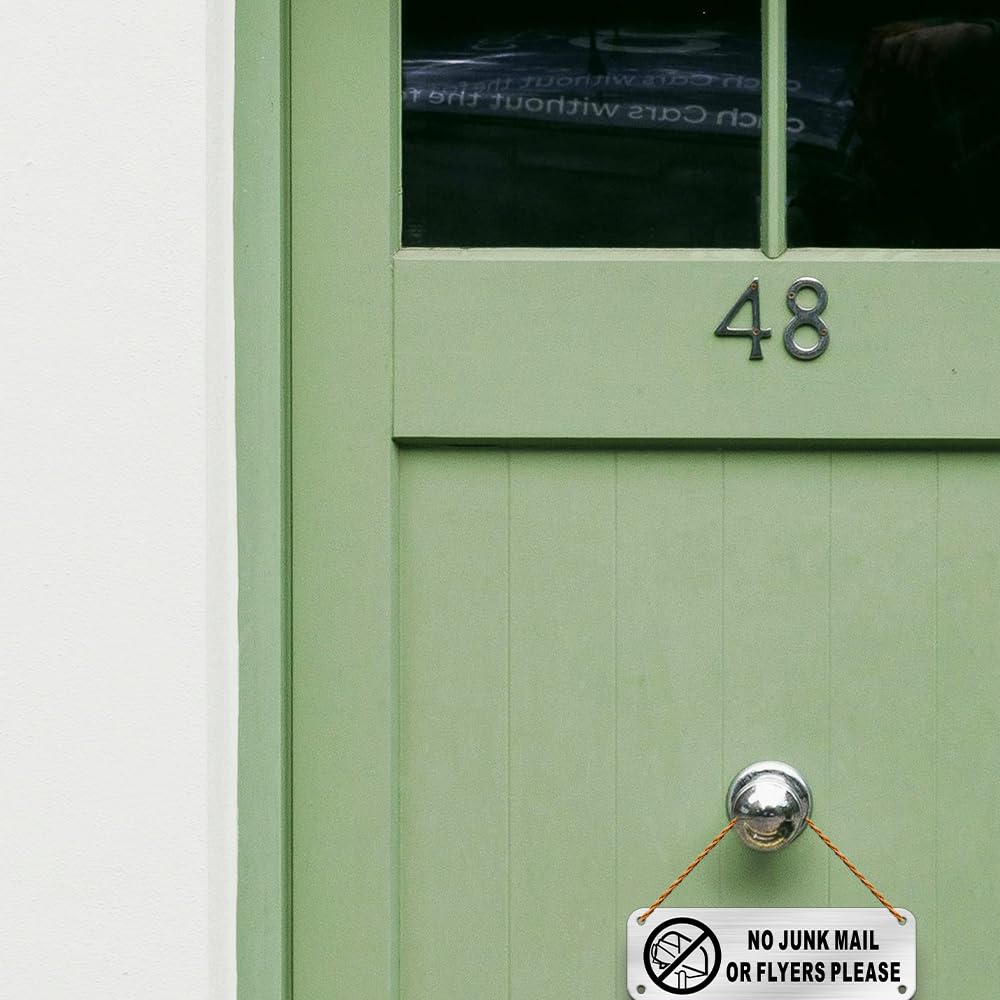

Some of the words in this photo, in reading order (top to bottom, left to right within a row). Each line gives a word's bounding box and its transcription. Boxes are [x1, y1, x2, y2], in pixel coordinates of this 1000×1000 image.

[714, 276, 830, 361] 48
[748, 930, 774, 950] NO
[778, 930, 829, 950] JUNK
[834, 930, 880, 950] MAIL
[726, 962, 752, 982] OR
[757, 961, 826, 982] FLYERS
[830, 961, 901, 982] PLEASE
